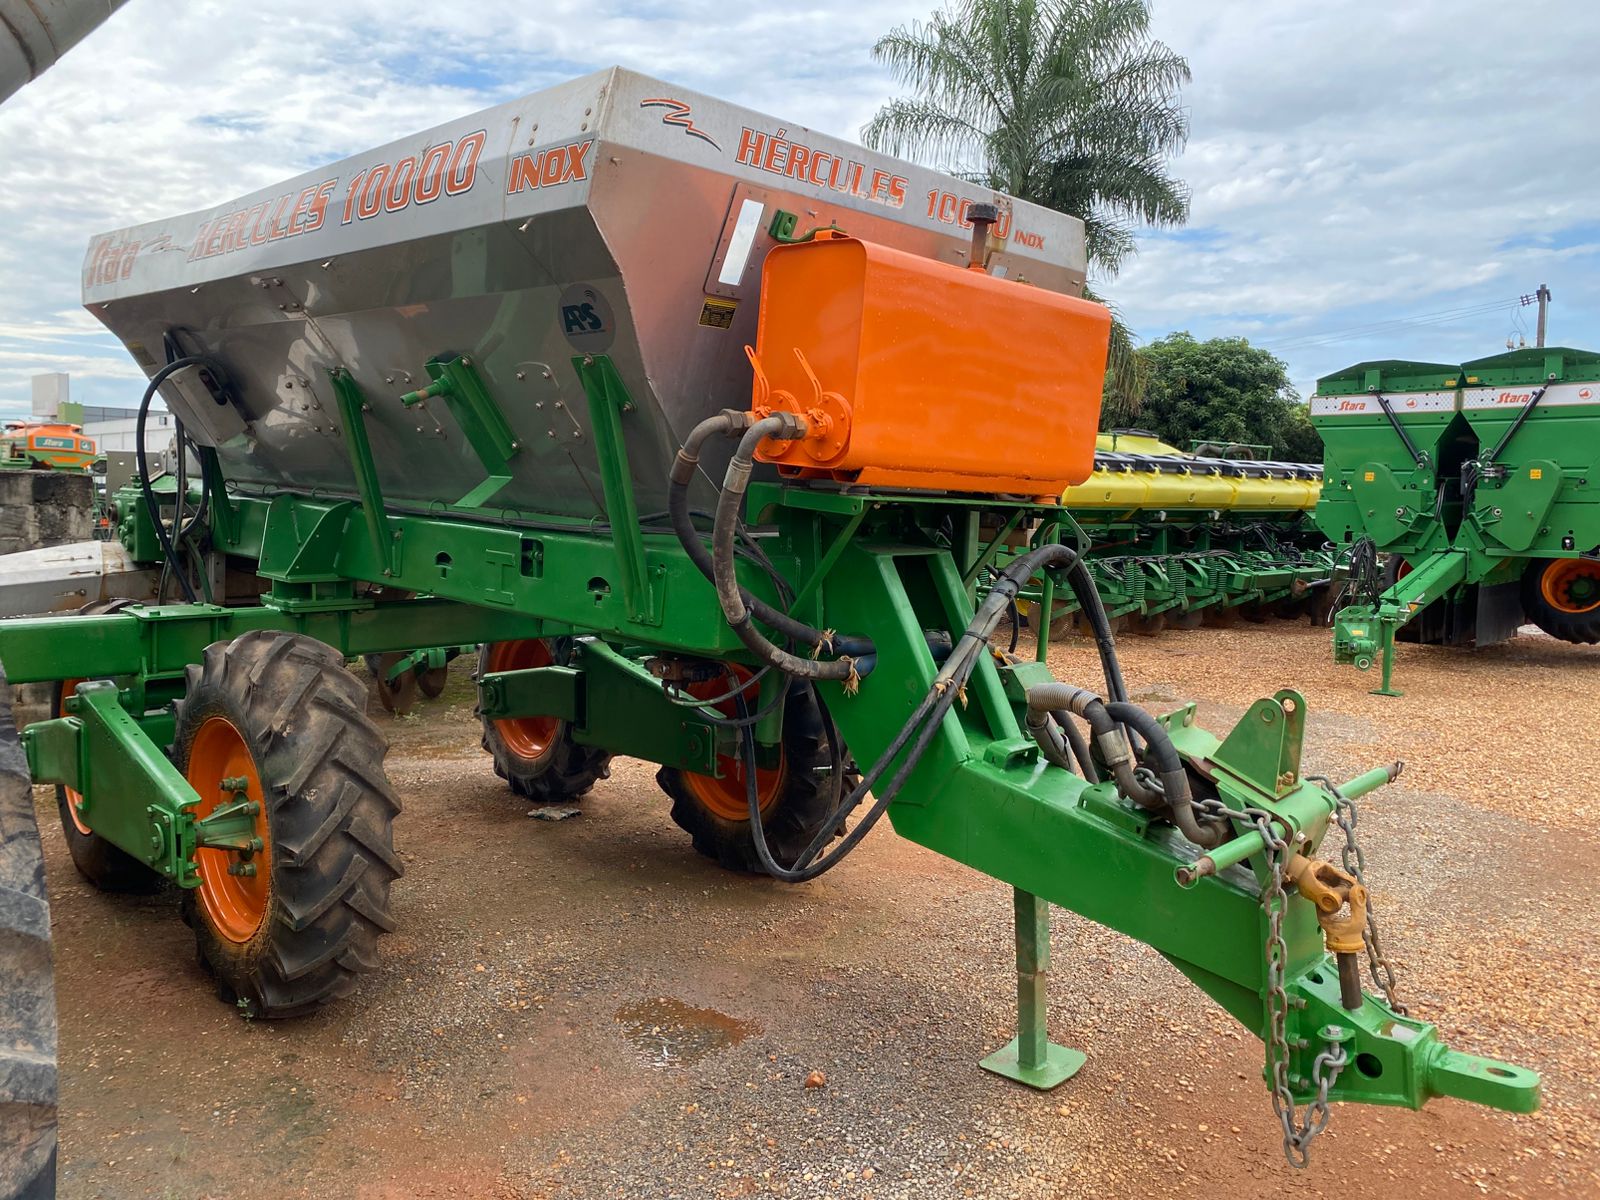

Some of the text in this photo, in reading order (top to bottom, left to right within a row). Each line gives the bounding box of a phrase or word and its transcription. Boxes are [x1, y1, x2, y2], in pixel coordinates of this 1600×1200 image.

[340, 129, 487, 226] 10000
[507, 138, 594, 195] INOX
[735, 126, 1046, 251] HÉRCULES 1000 INOX
[1338, 400, 1366, 411] Stara
[1497, 392, 1530, 404] Stara
